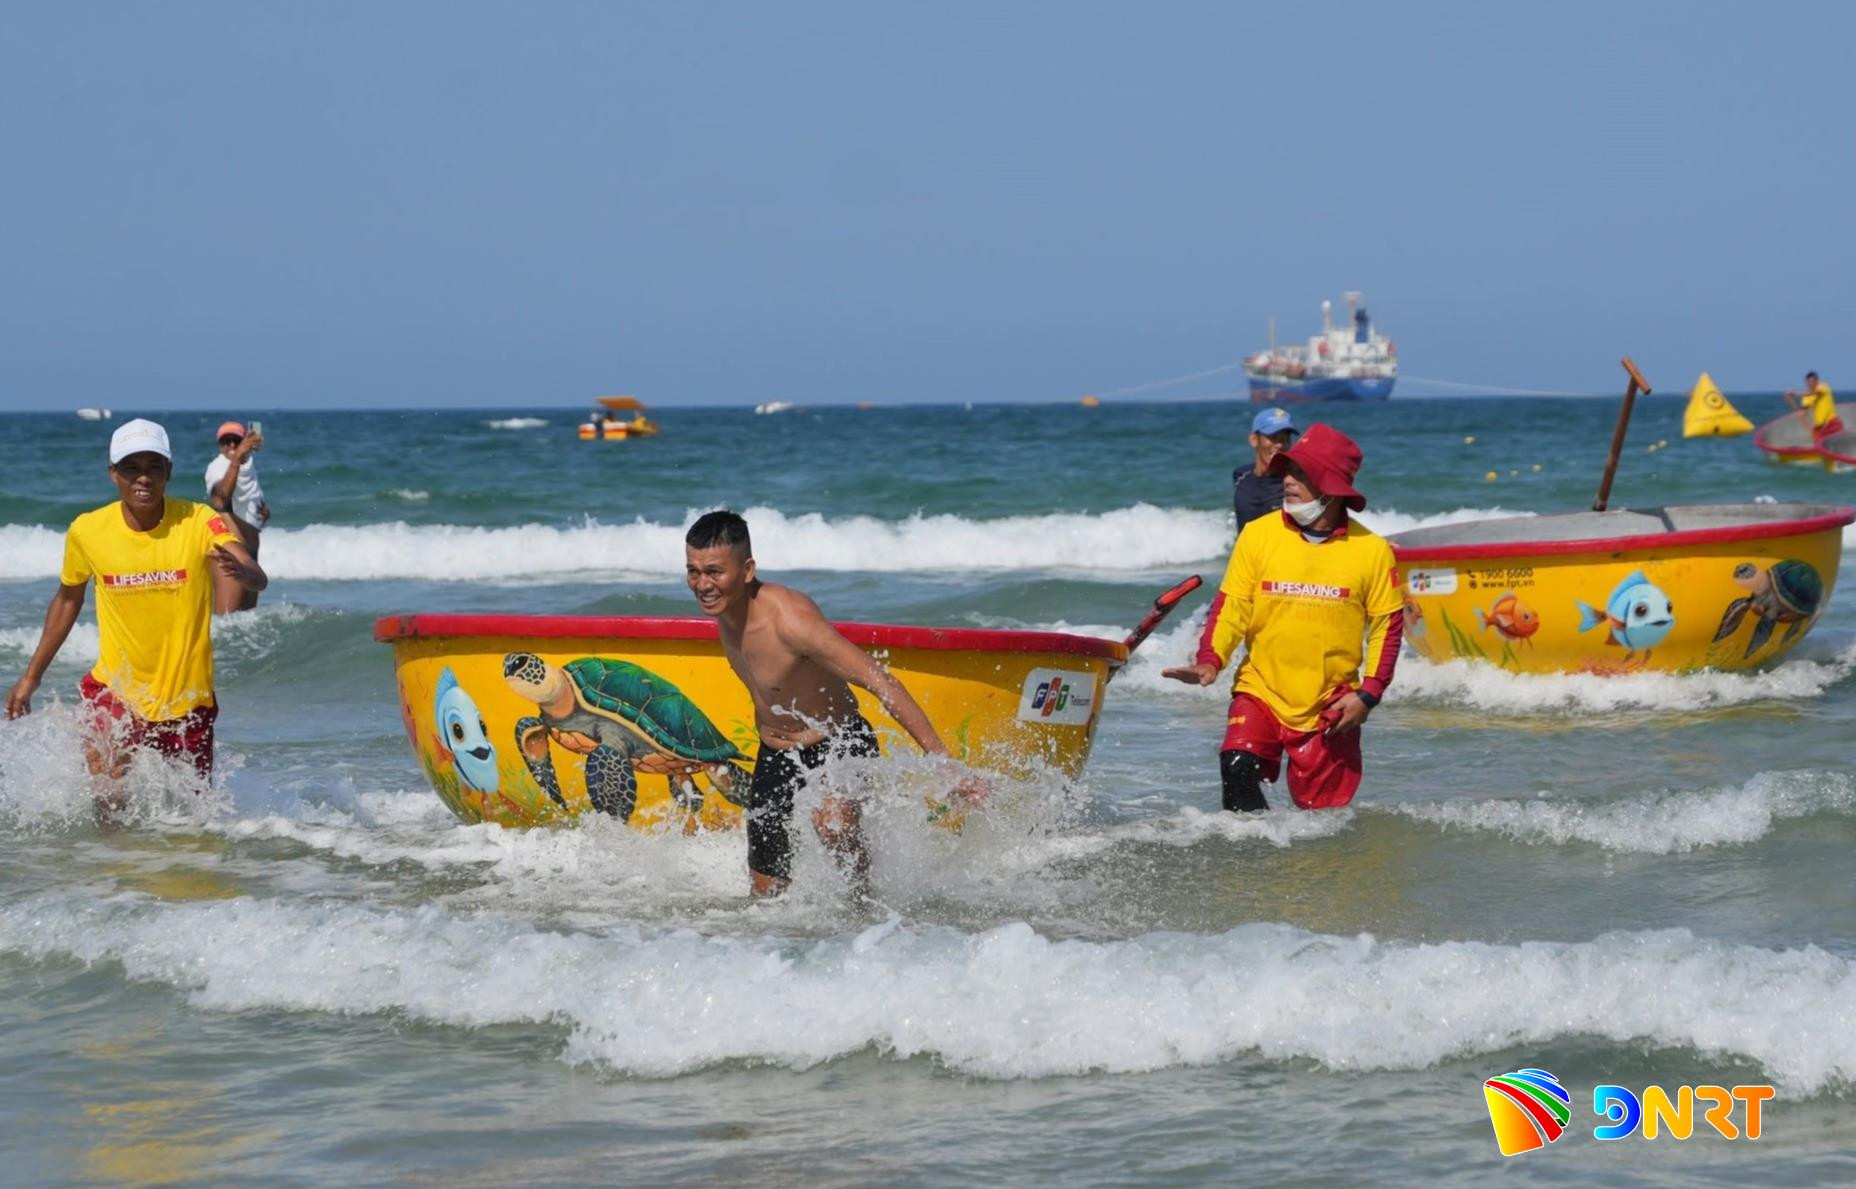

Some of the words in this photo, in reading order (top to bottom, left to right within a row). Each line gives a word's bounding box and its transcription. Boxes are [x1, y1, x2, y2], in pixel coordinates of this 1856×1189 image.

[113, 570, 177, 586] LIFESAVING
[1480, 569, 1503, 579] 1900
[1271, 581, 1341, 598] LIFESAVING
[1482, 578, 1534, 589] www.fpt.vn
[1031, 677, 1070, 717] FPT
